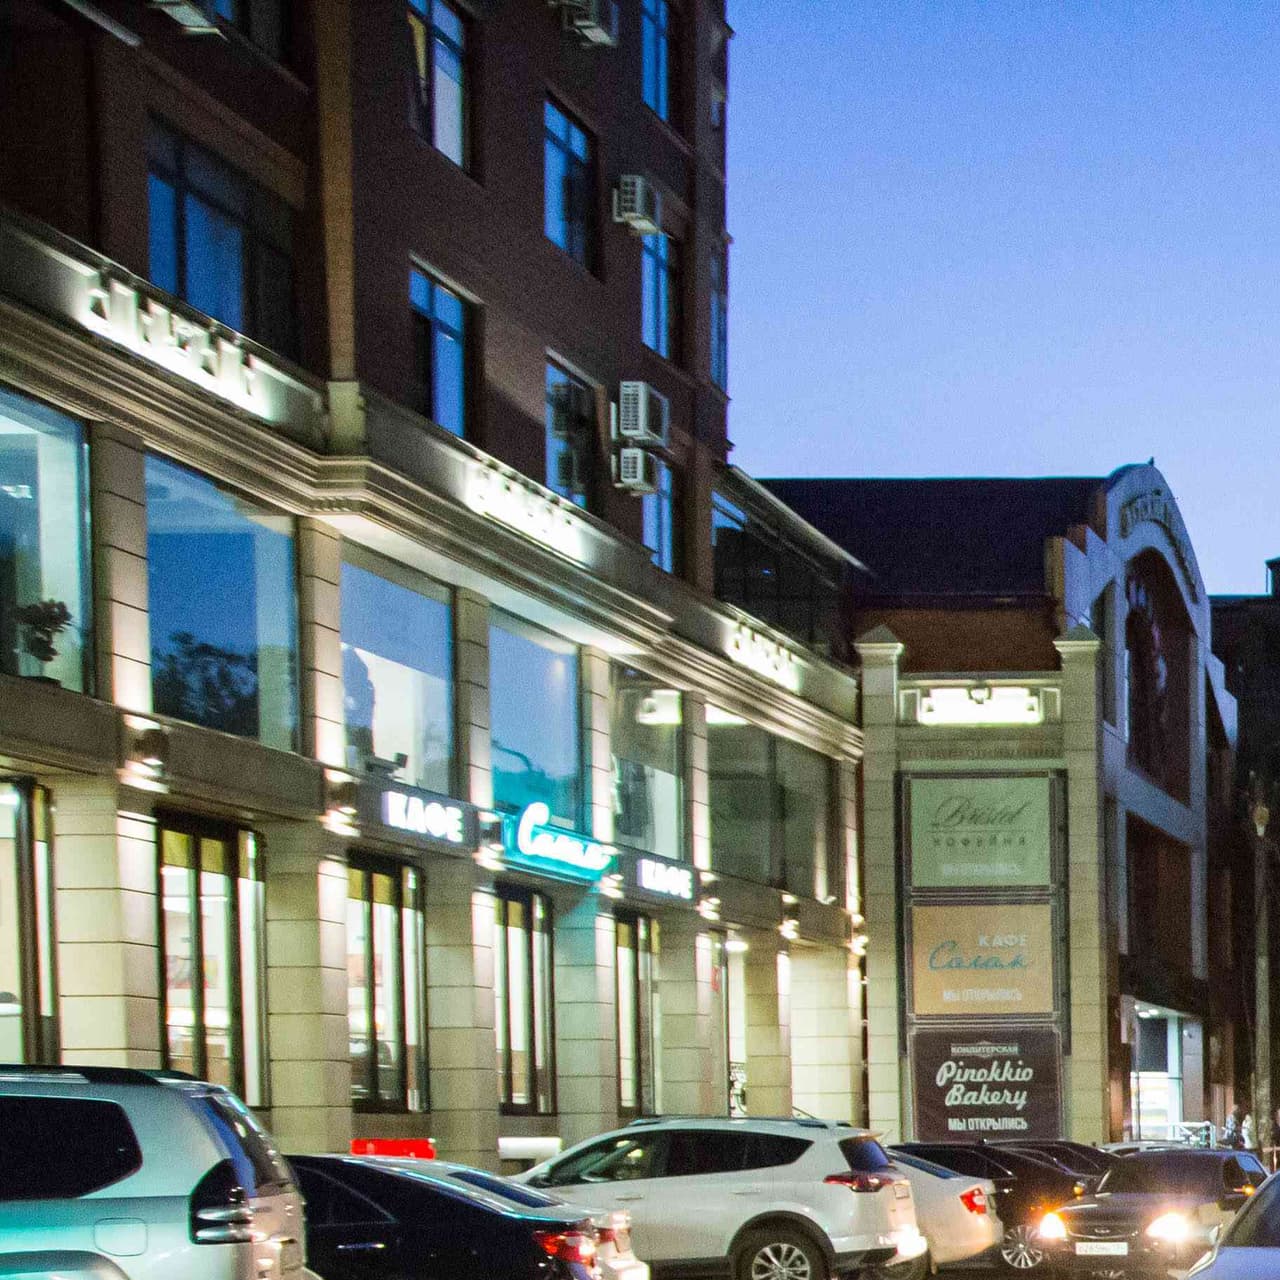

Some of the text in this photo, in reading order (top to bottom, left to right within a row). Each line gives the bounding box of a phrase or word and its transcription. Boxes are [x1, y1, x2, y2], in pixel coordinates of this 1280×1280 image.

[381, 790, 464, 843] КАФЕ
[979, 931, 1028, 947] КАФЕ
[936, 1060, 1034, 1087] Pinokkio
[945, 1083, 1028, 1111] Bakery
[948, 1117, 1028, 1131] МЫ ОТКРЫЛИСЬ
